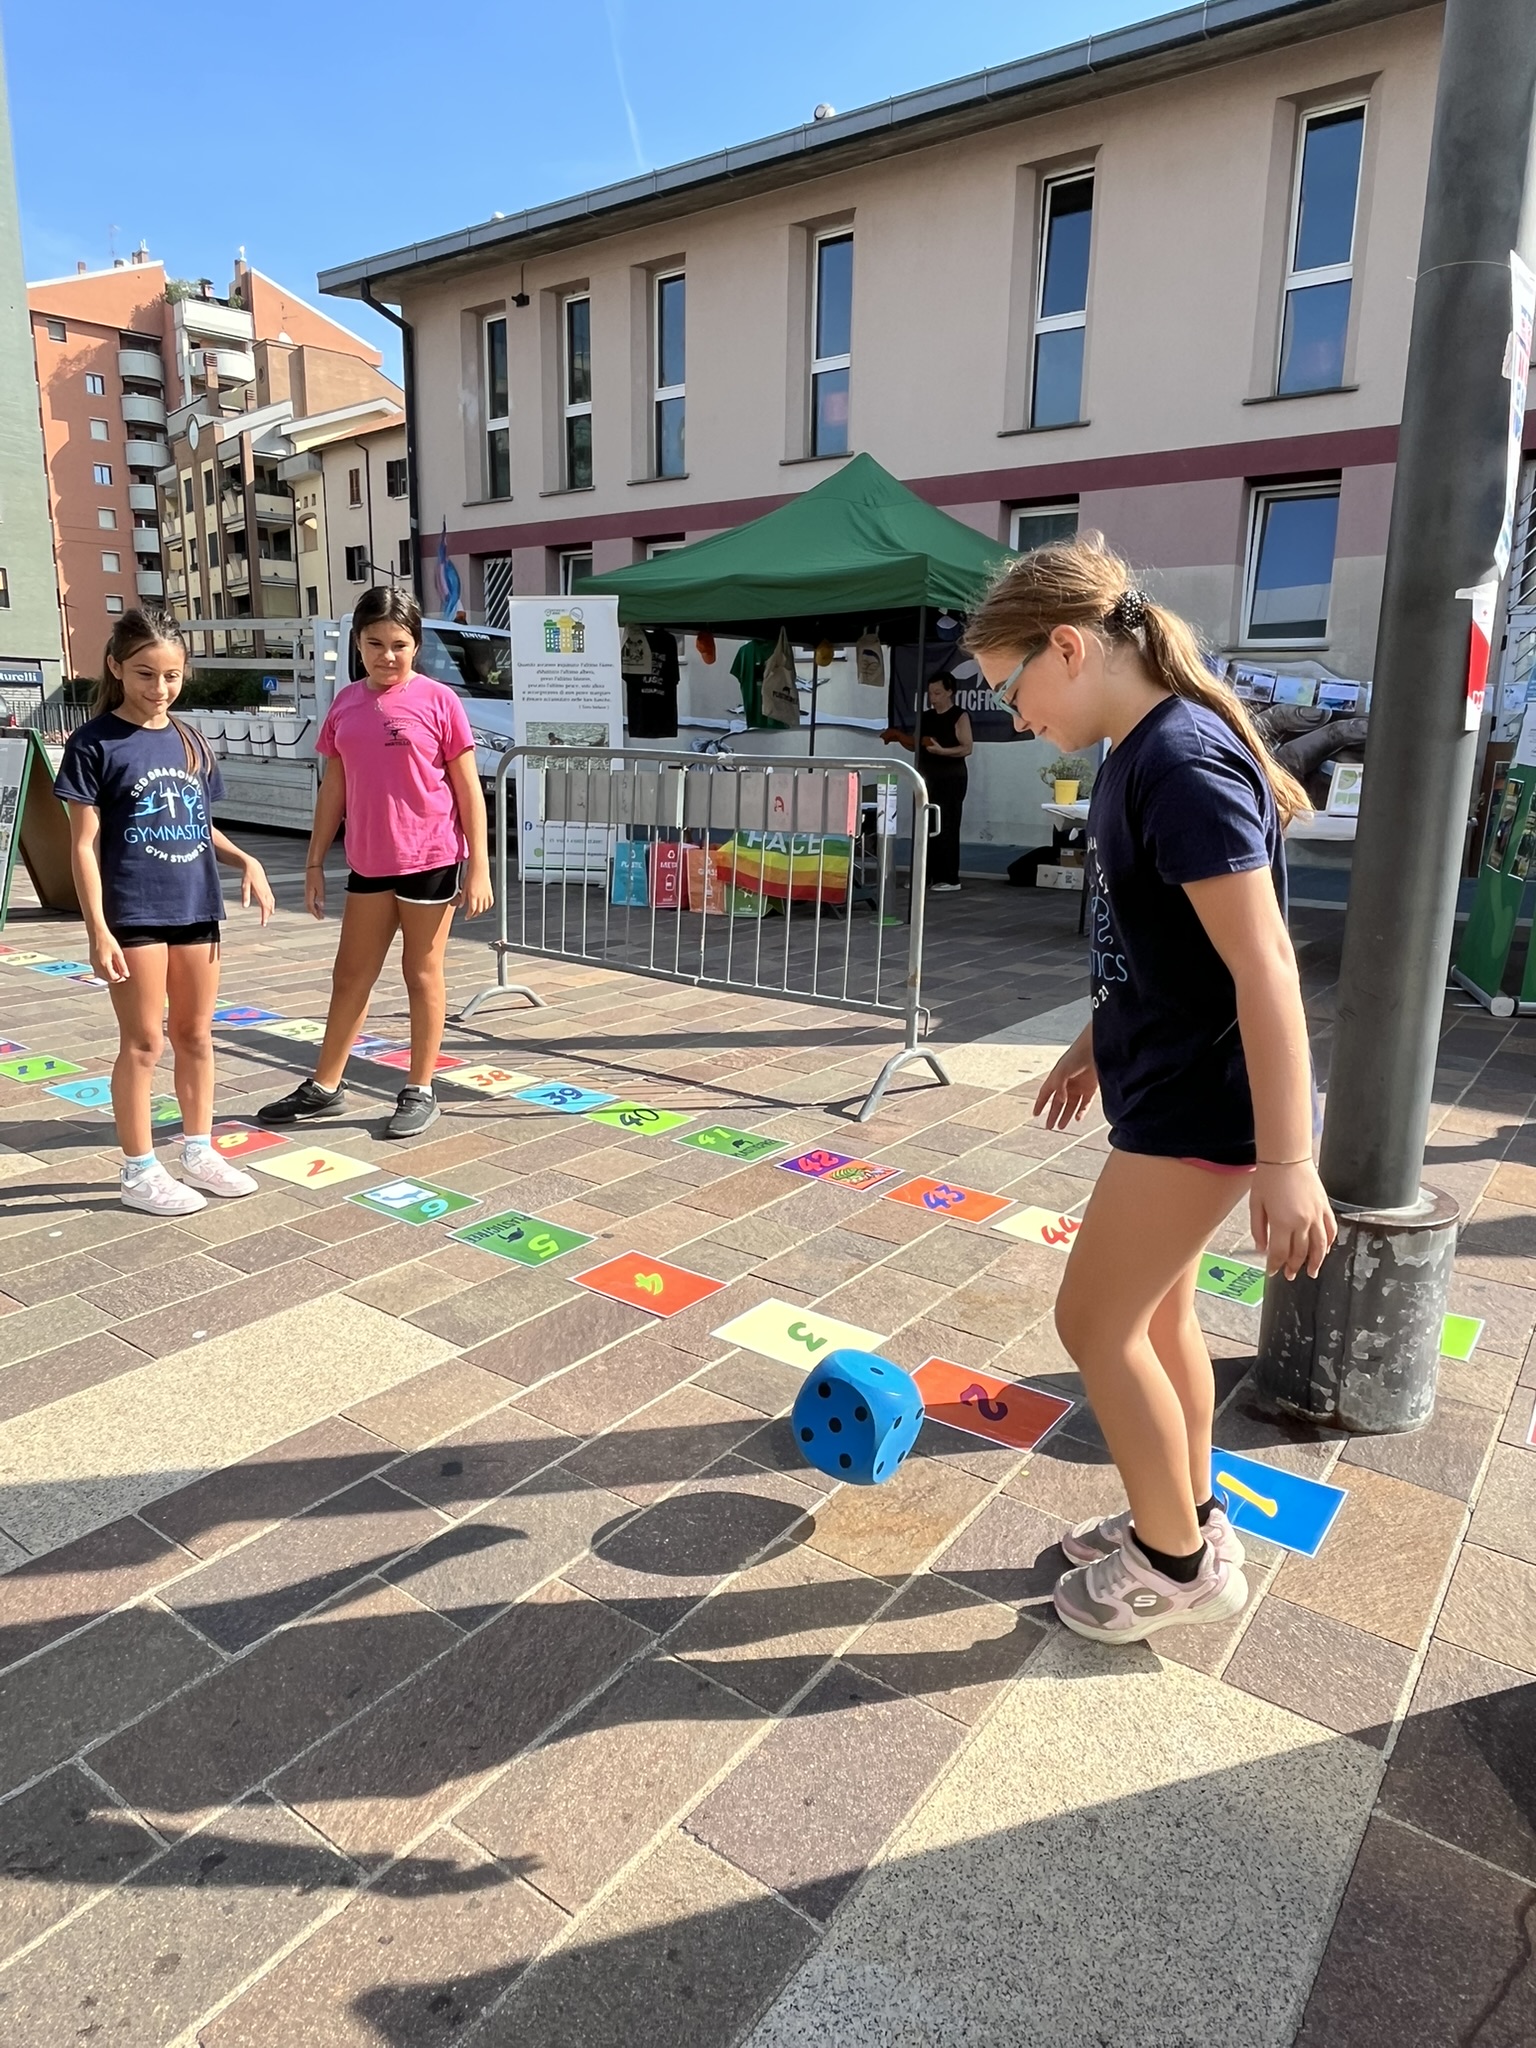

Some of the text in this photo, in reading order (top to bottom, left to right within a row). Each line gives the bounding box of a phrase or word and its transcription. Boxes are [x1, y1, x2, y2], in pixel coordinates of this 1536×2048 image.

[130, 777, 149, 799] SSD
[145, 844, 168, 861] GYM
[620, 861, 643, 869] PLSTIC
[281, 1023, 319, 1037] 35
[468, 1070, 512, 1087] 38
[540, 1087, 583, 1106] 39
[619, 1108, 660, 1127] 40
[216, 1131, 249, 1149] 8
[697, 1127, 732, 1146] 41
[798, 1150, 840, 1173] 42
[921, 1184, 966, 1210] 43
[1040, 1215, 1083, 1245] 44
[528, 1233, 559, 1259] 5
[634, 1272, 664, 1296] 4
[787, 1321, 828, 1353] 3
[959, 1382, 1009, 1422] 2
